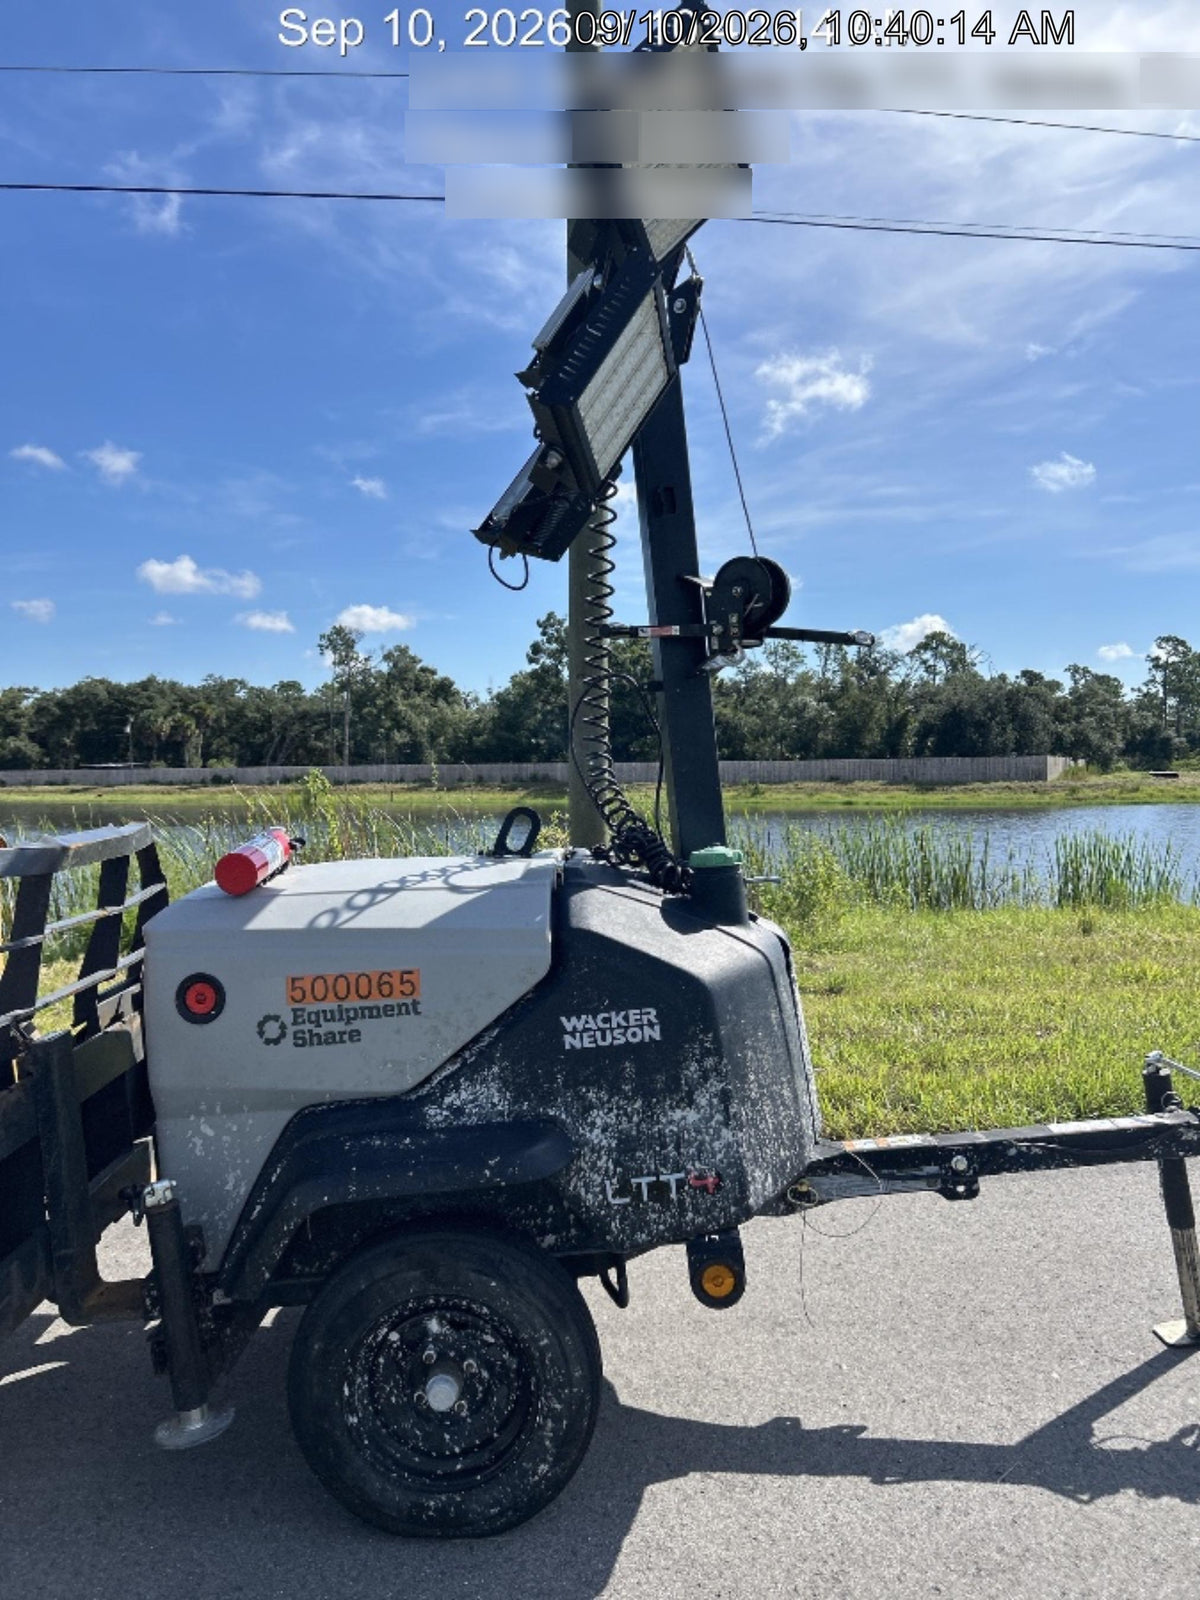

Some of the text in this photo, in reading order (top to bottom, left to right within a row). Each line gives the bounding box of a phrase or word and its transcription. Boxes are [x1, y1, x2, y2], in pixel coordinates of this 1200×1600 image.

[290, 970, 417, 1003] 500065
[291, 998, 422, 1028] Equipment
[559, 1008, 659, 1032] WACKER
[292, 1028, 362, 1048] Share
[563, 1024, 661, 1050] NEUSON
